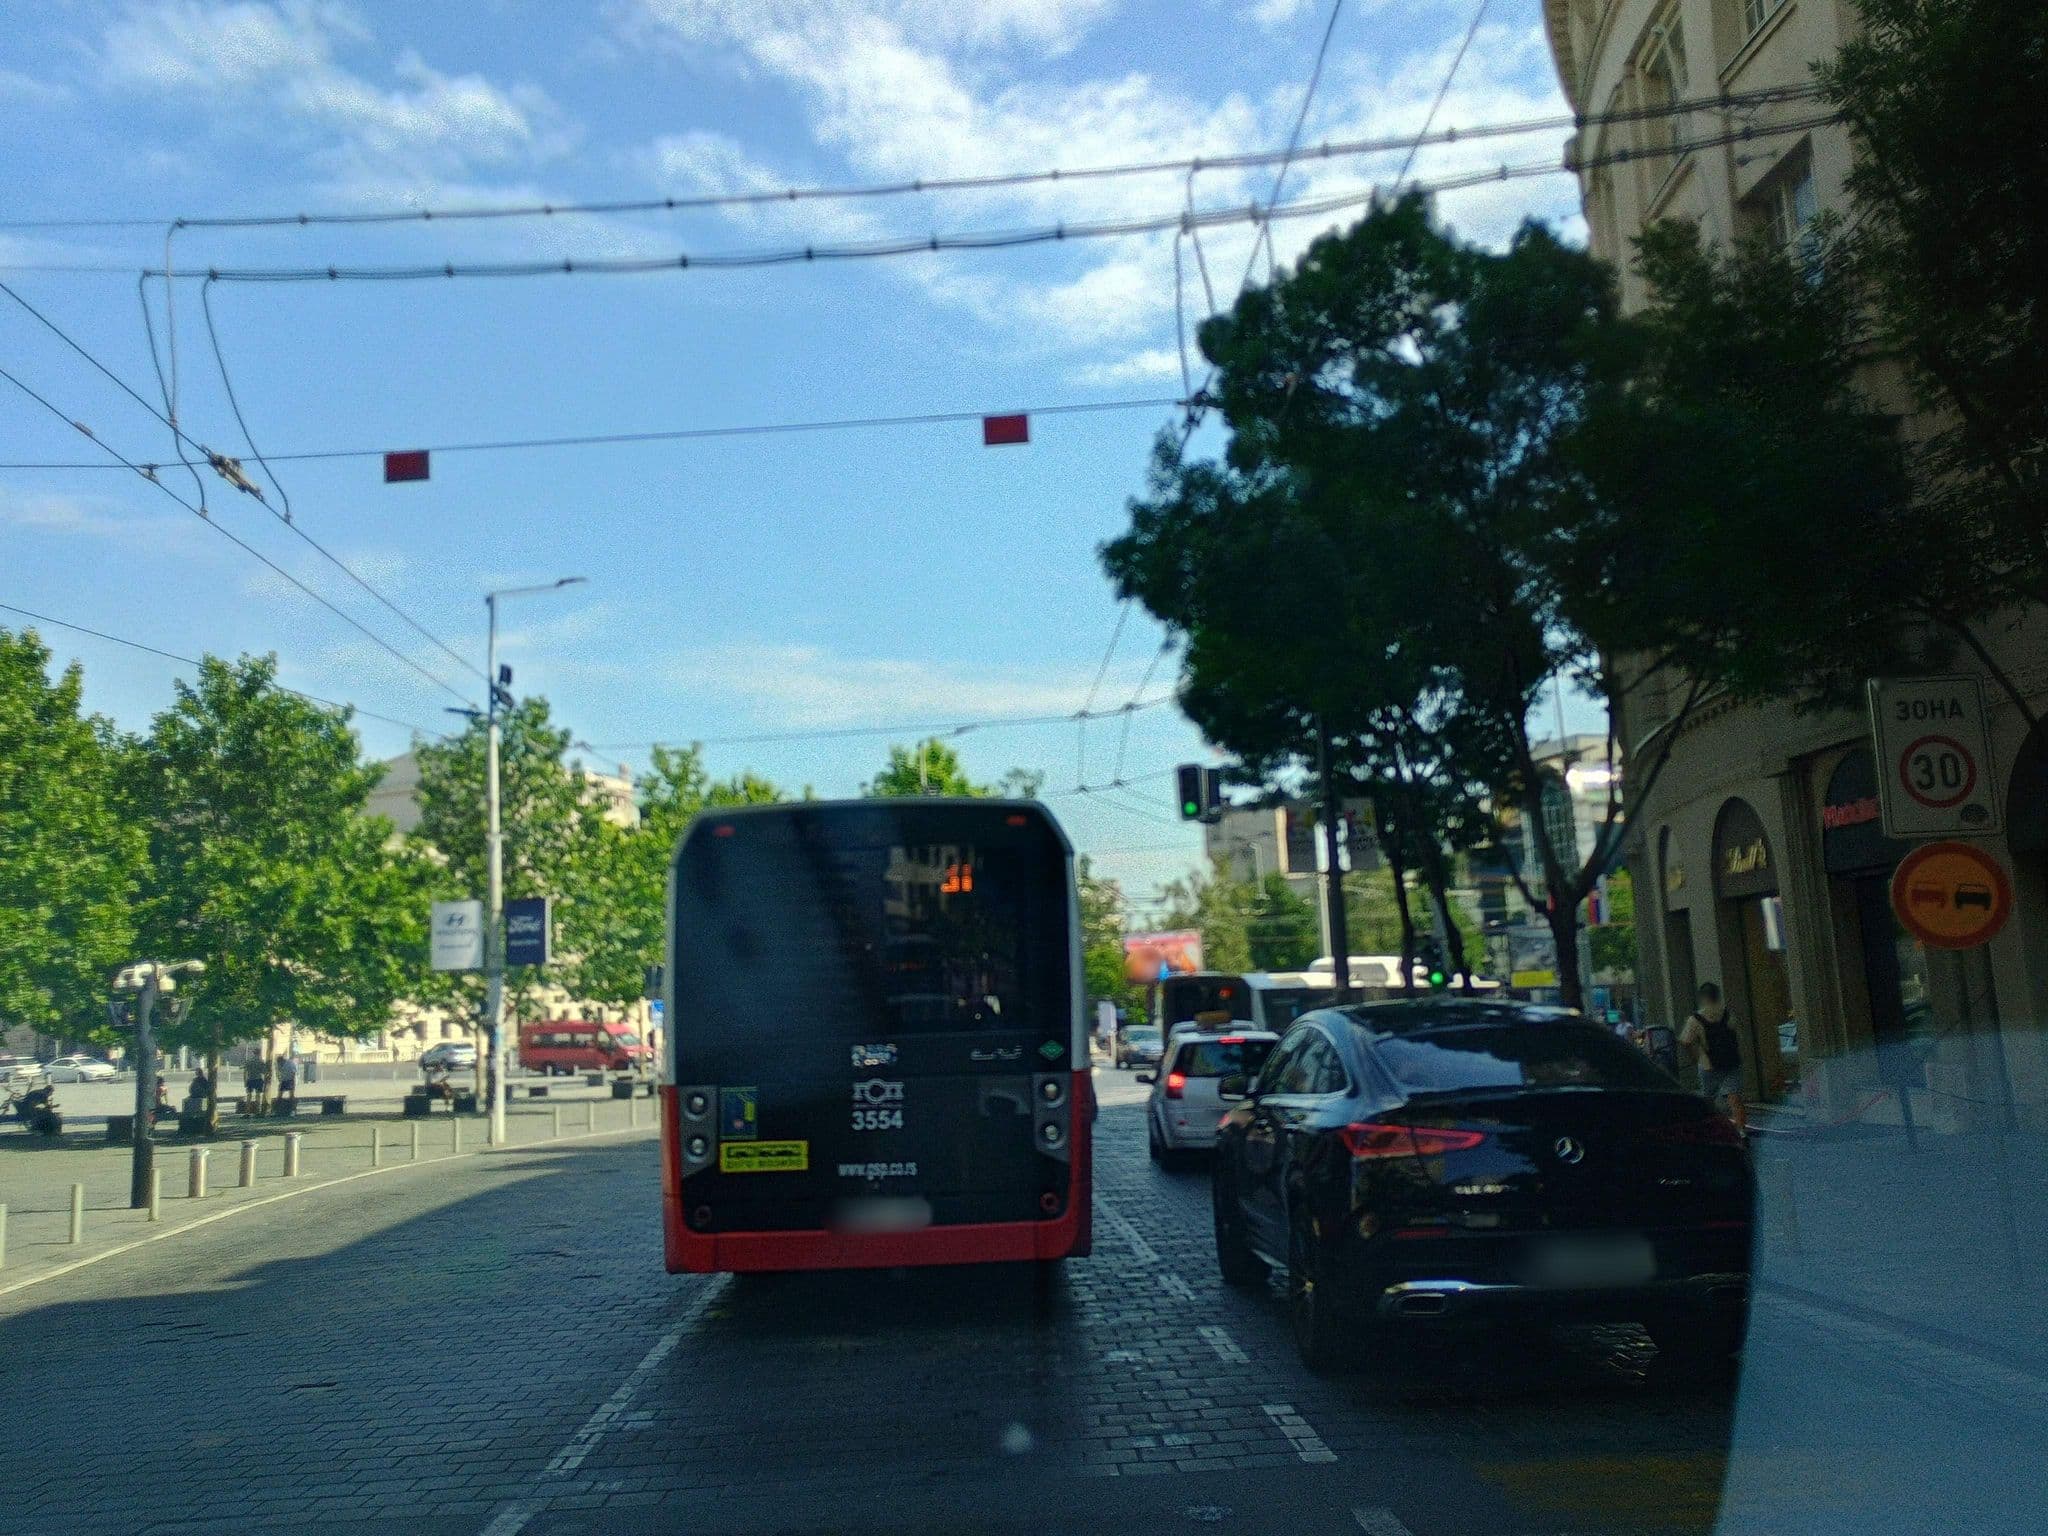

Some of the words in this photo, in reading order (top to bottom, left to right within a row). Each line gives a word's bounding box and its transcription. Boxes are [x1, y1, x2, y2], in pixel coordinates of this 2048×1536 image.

[1896, 699, 1964, 721] ЗОНА
[1913, 752, 1961, 790] 30
[851, 1110, 904, 1130] 3554
